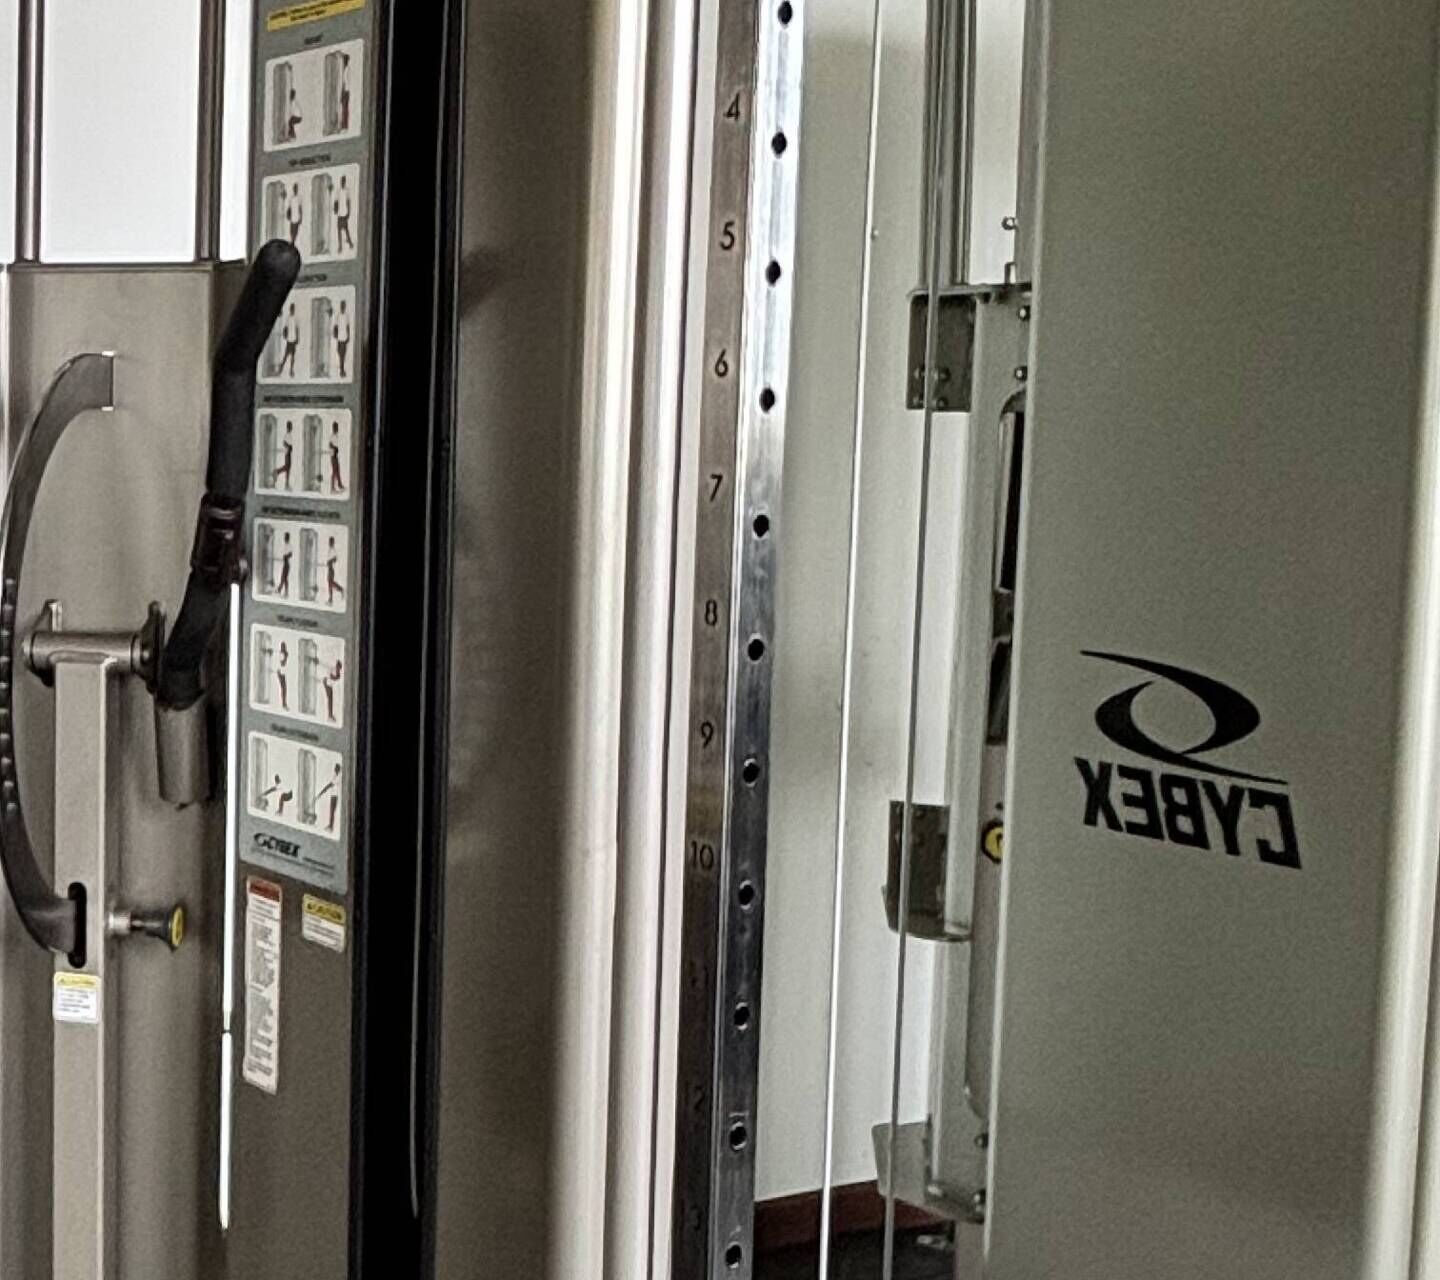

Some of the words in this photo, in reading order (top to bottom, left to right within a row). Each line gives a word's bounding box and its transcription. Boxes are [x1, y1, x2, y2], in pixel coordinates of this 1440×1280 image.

[724, 92, 742, 121] 4
[720, 222, 736, 250] 5
[714, 348, 729, 377] 6
[709, 474, 724, 503] 7
[704, 599, 718, 627] 8
[700, 721, 715, 748] 9
[690, 841, 715, 871] 10
